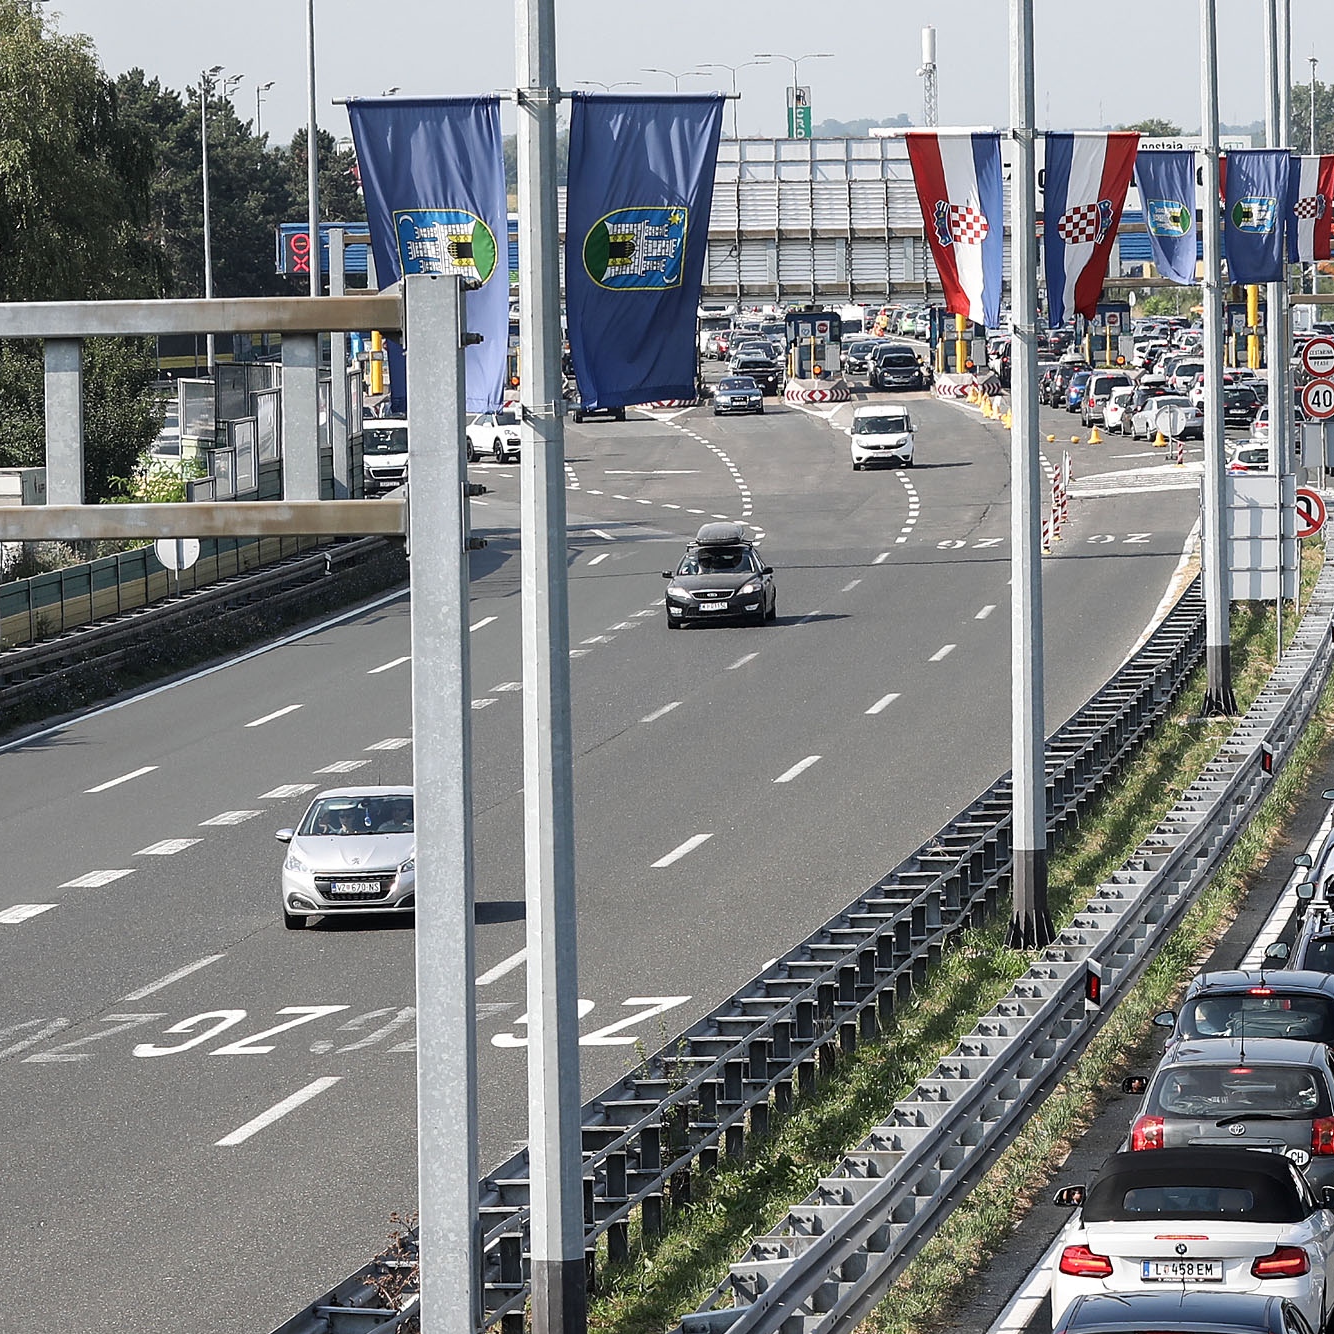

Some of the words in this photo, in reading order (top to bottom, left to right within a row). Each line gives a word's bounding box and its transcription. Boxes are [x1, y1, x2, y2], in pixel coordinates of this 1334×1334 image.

[1311, 389, 1332, 408] 40
[1155, 1263, 1162, 1276] L
[1171, 1263, 1194, 1276] 458
[1198, 1264, 1213, 1276] EM
